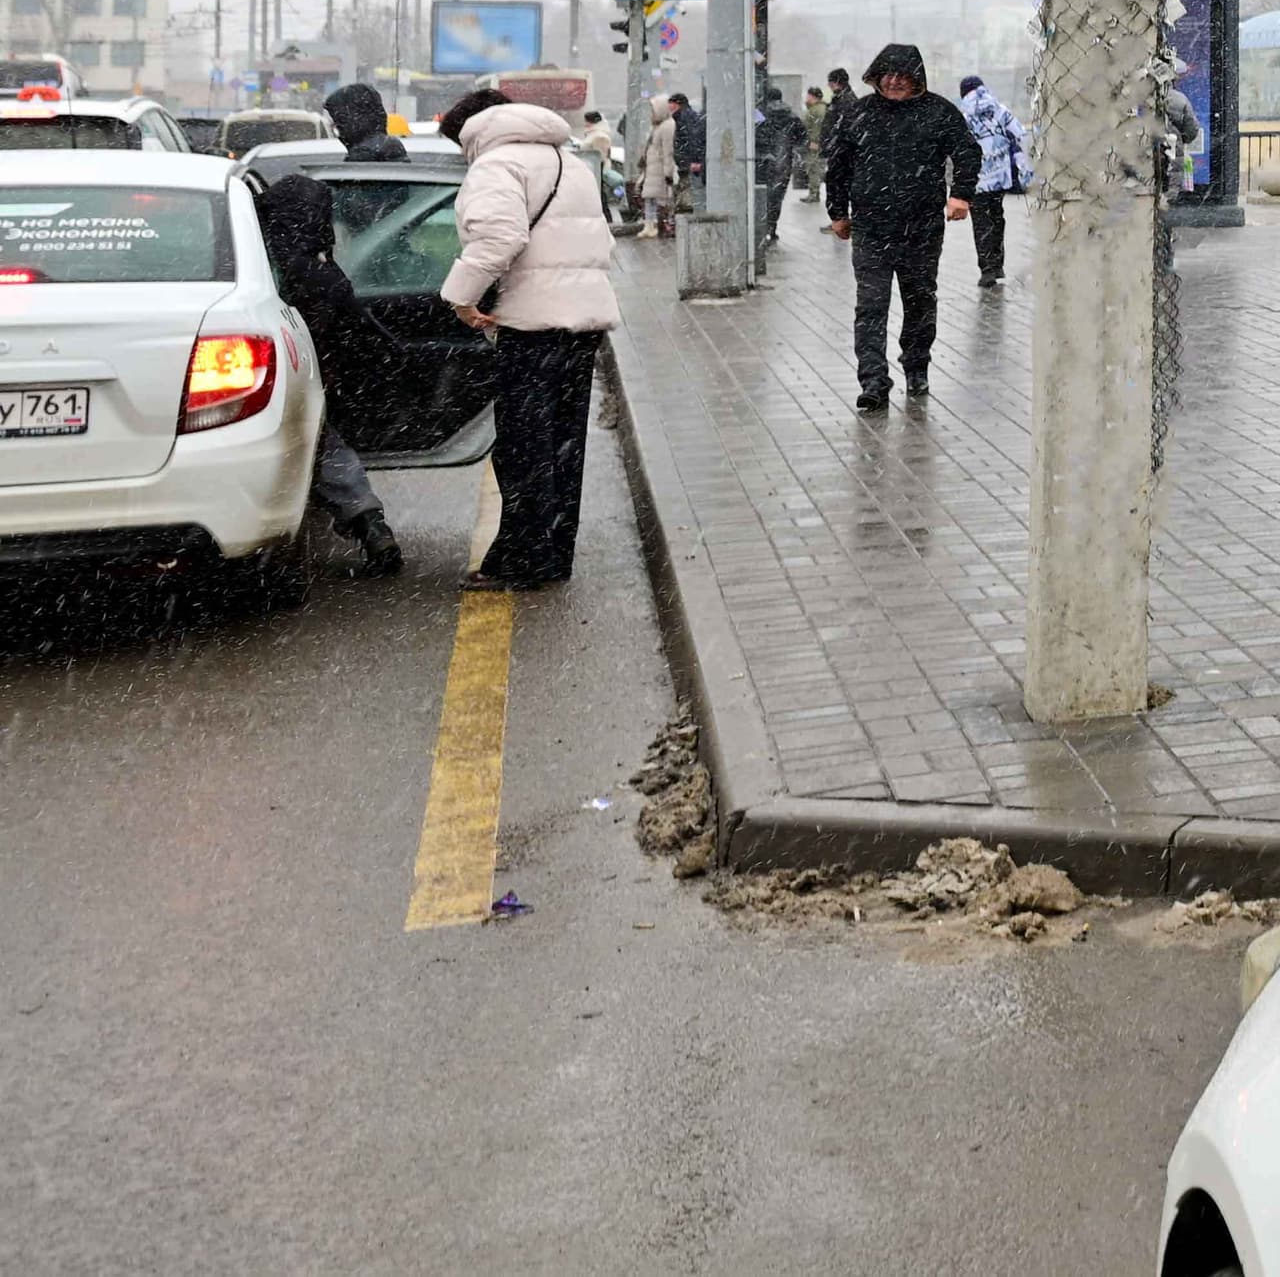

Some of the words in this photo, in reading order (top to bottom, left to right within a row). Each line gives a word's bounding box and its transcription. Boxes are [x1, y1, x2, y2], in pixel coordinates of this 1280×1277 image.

[21, 219, 53, 227] на
[58, 217, 150, 228] метане.
[5, 228, 160, 240] Экономично.
[26, 394, 77, 417] 761
